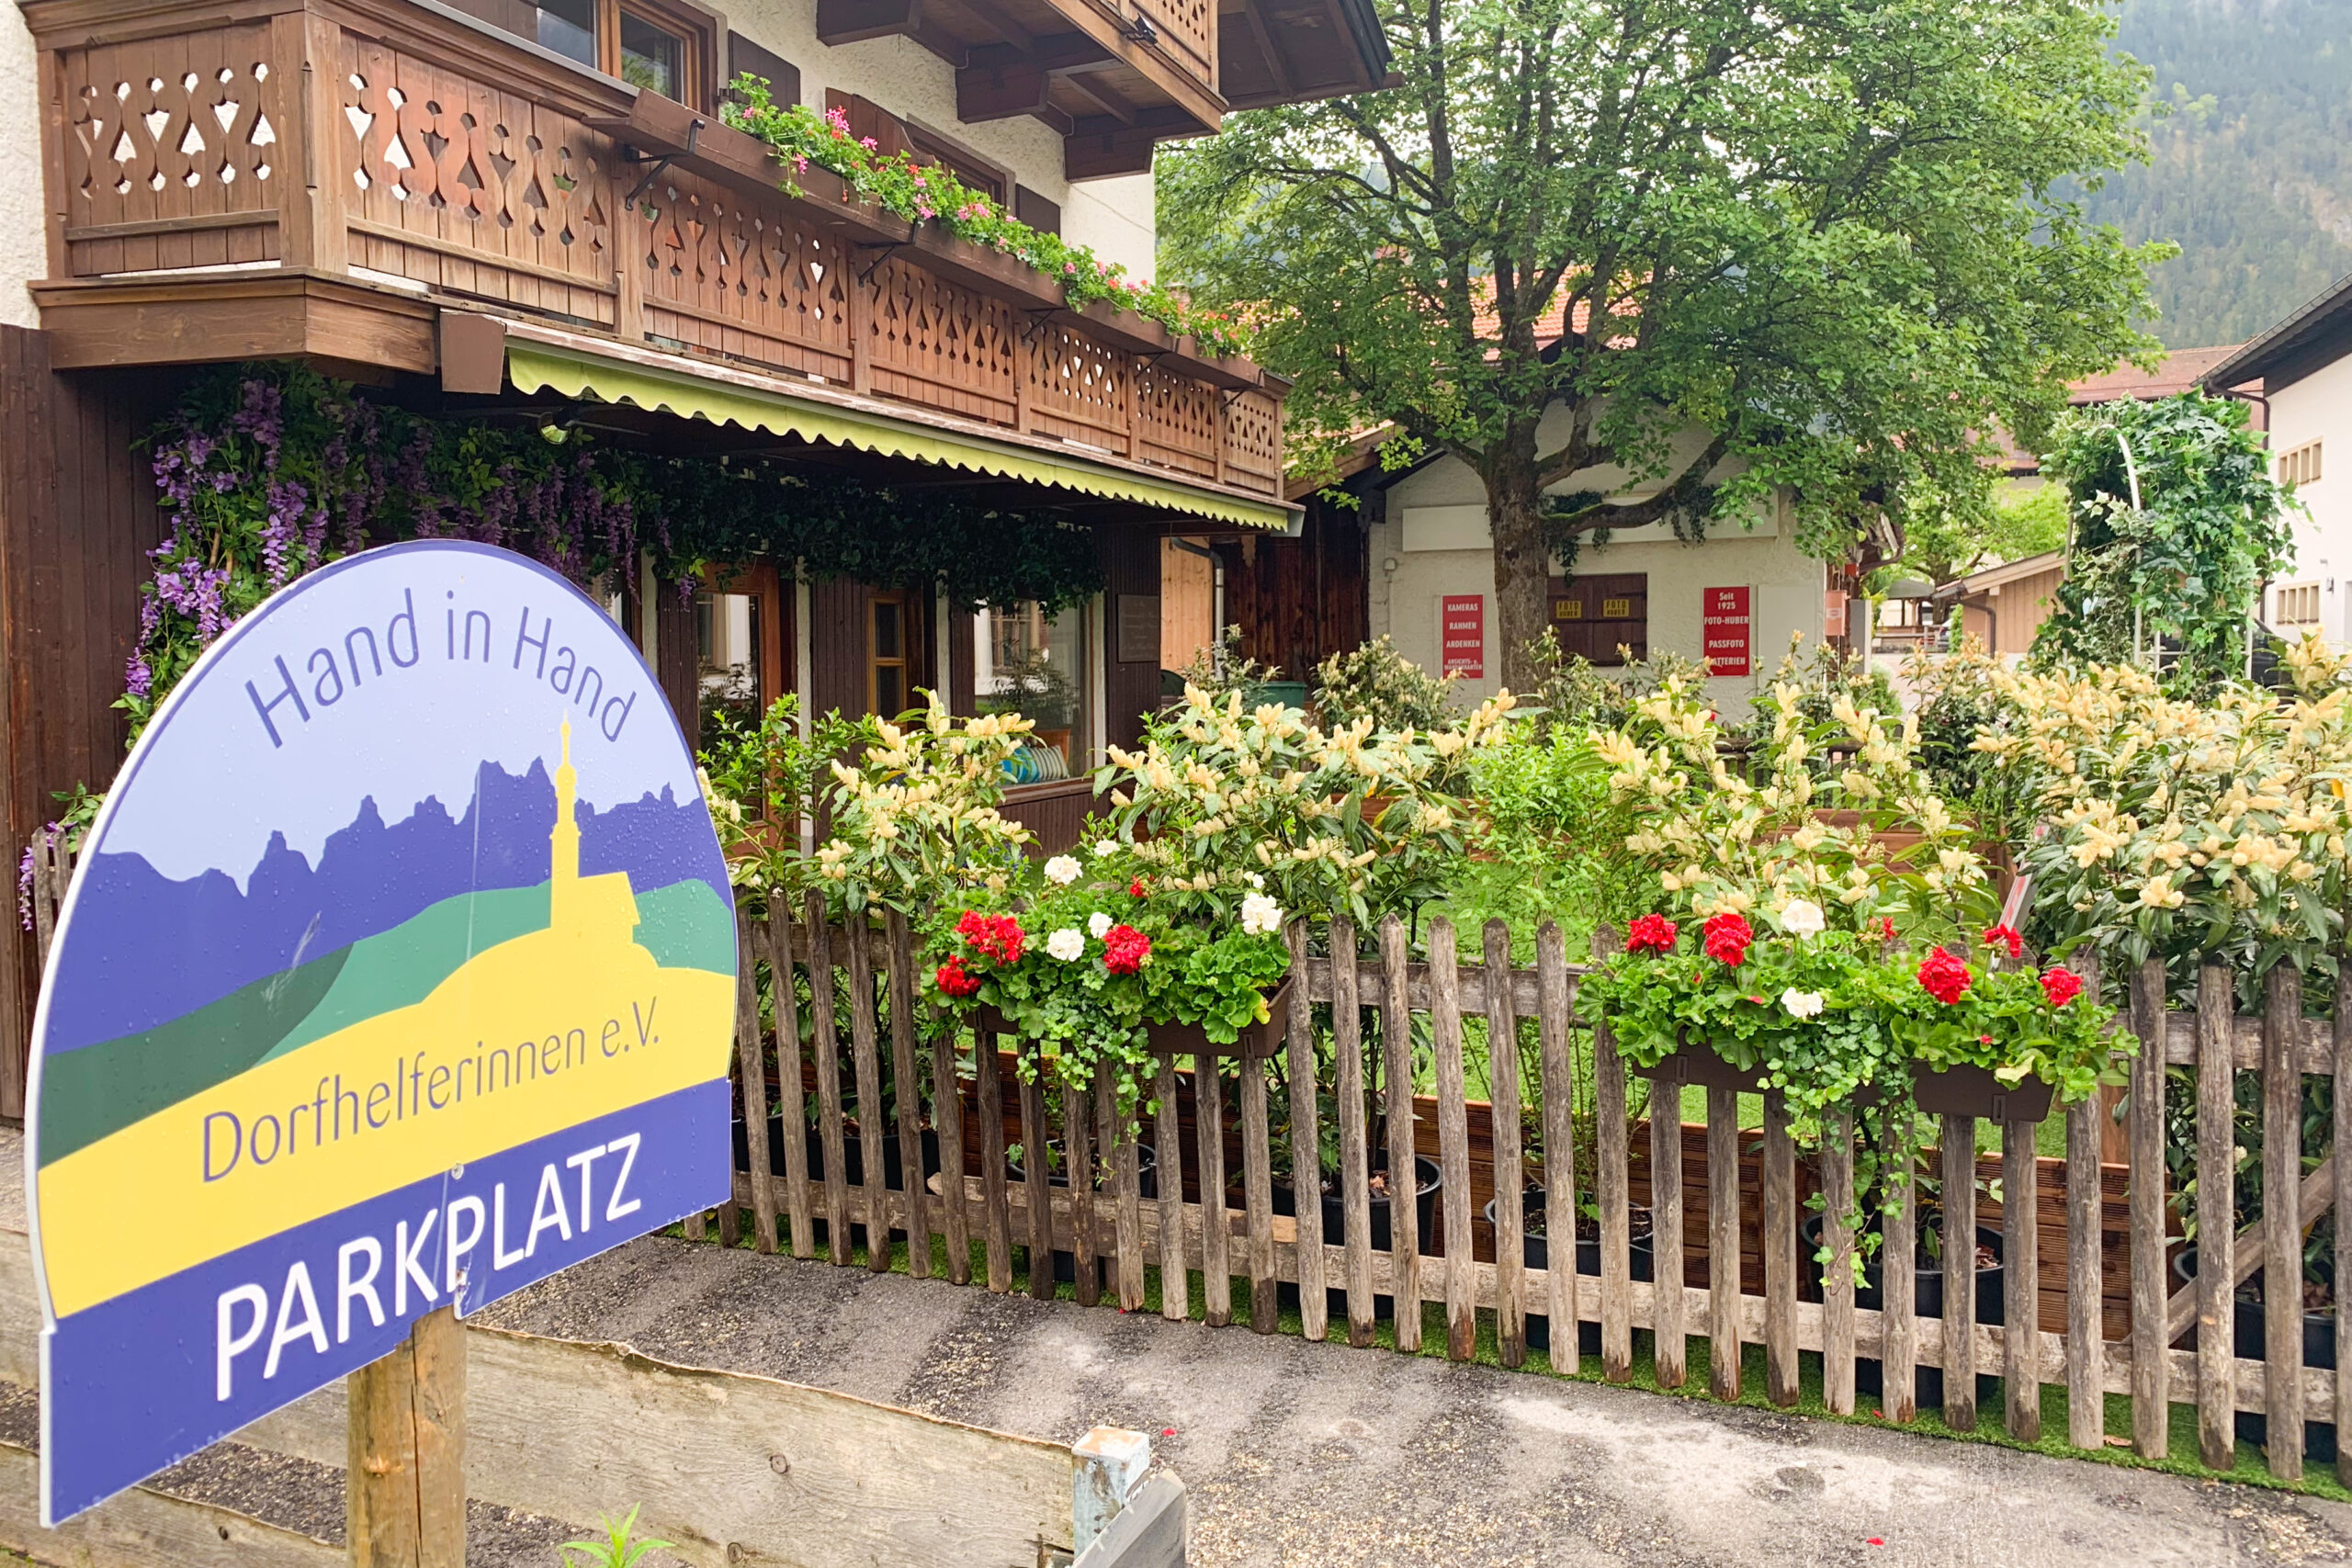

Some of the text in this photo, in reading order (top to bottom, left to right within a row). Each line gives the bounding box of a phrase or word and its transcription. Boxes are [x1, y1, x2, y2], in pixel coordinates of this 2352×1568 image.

[1719, 592, 1735, 601] Seit
[1447, 603, 1478, 612] KAMERAS
[1717, 602, 1736, 610] 1925
[1449, 621, 1477, 630] RAHMEN
[1704, 615, 1749, 626] FOTO-HUBER
[1446, 639, 1480, 649] ANDENKEN
[1708, 639, 1745, 649] PASSFOTO
[1710, 657, 1746, 665] ATTERIEN
[243, 586, 637, 750] Hand in Hand
[200, 995, 662, 1184] Dorfhelferinnen e.V.
[214, 1131, 642, 1403] PARKPLATZ
